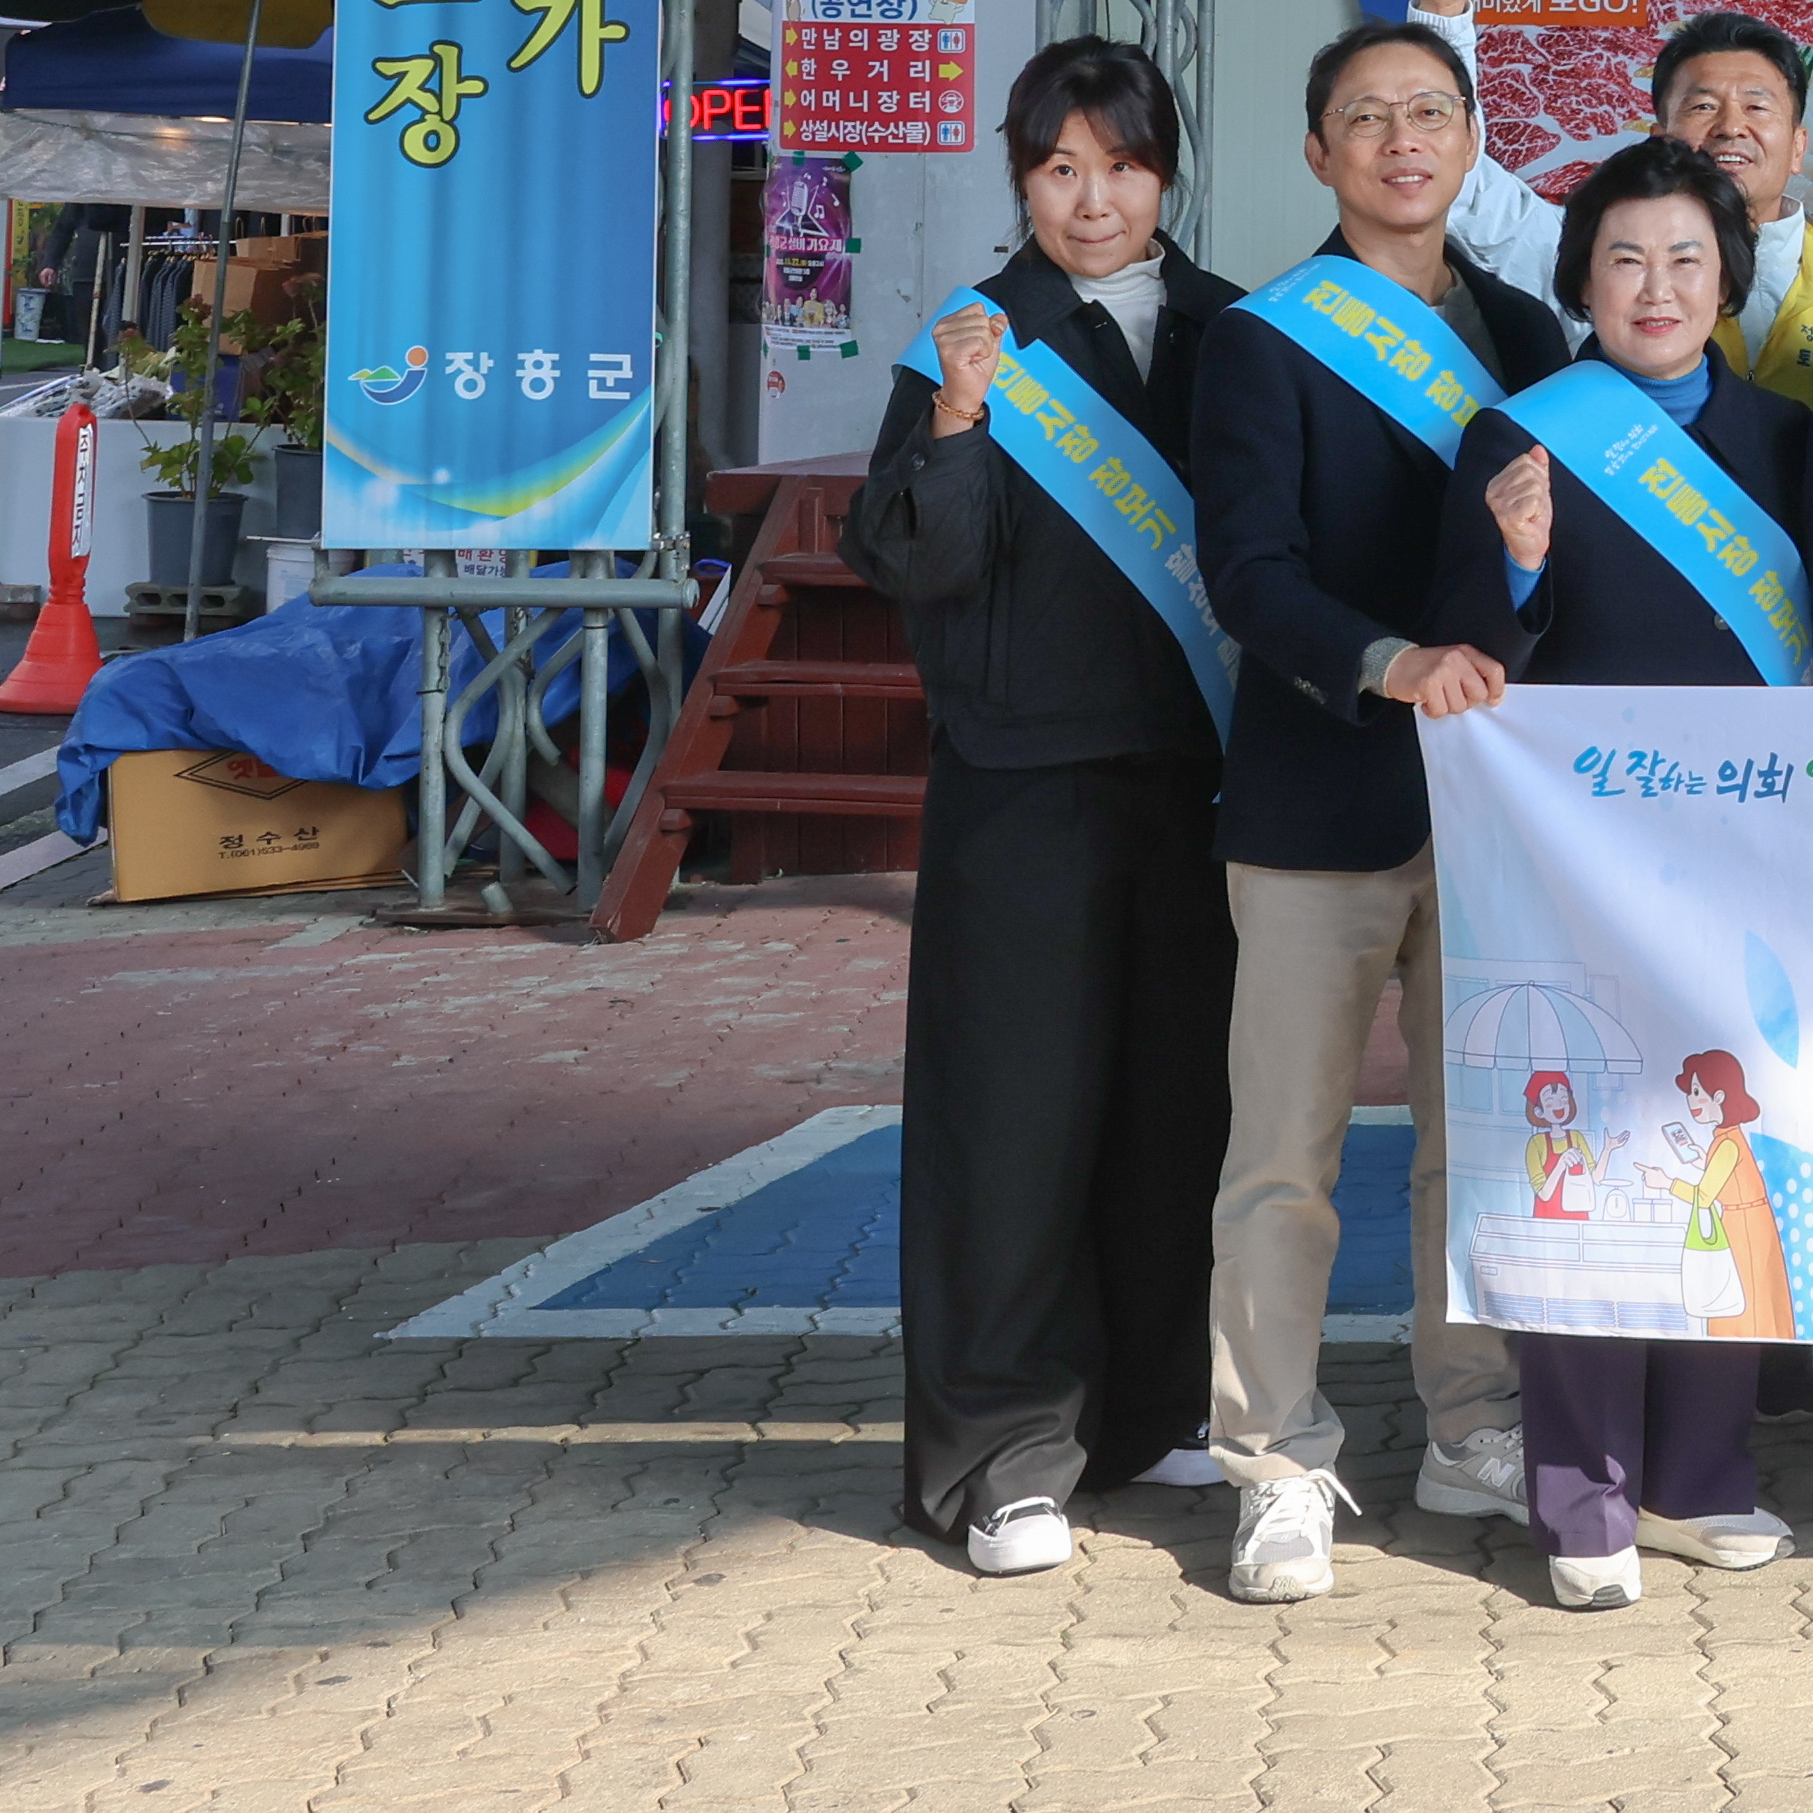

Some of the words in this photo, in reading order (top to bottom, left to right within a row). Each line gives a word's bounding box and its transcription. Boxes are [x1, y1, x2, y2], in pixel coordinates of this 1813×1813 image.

[800, 119, 931, 145] 상설시장(수산물)
[1303, 280, 1432, 381] 전통시장
[1089, 456, 1178, 552] 장보기
[1637, 457, 1760, 577] 전통시장
[1573, 745, 1625, 798] 일
[1625, 748, 1708, 798] 잘하는
[1716, 751, 1795, 802] 의회
